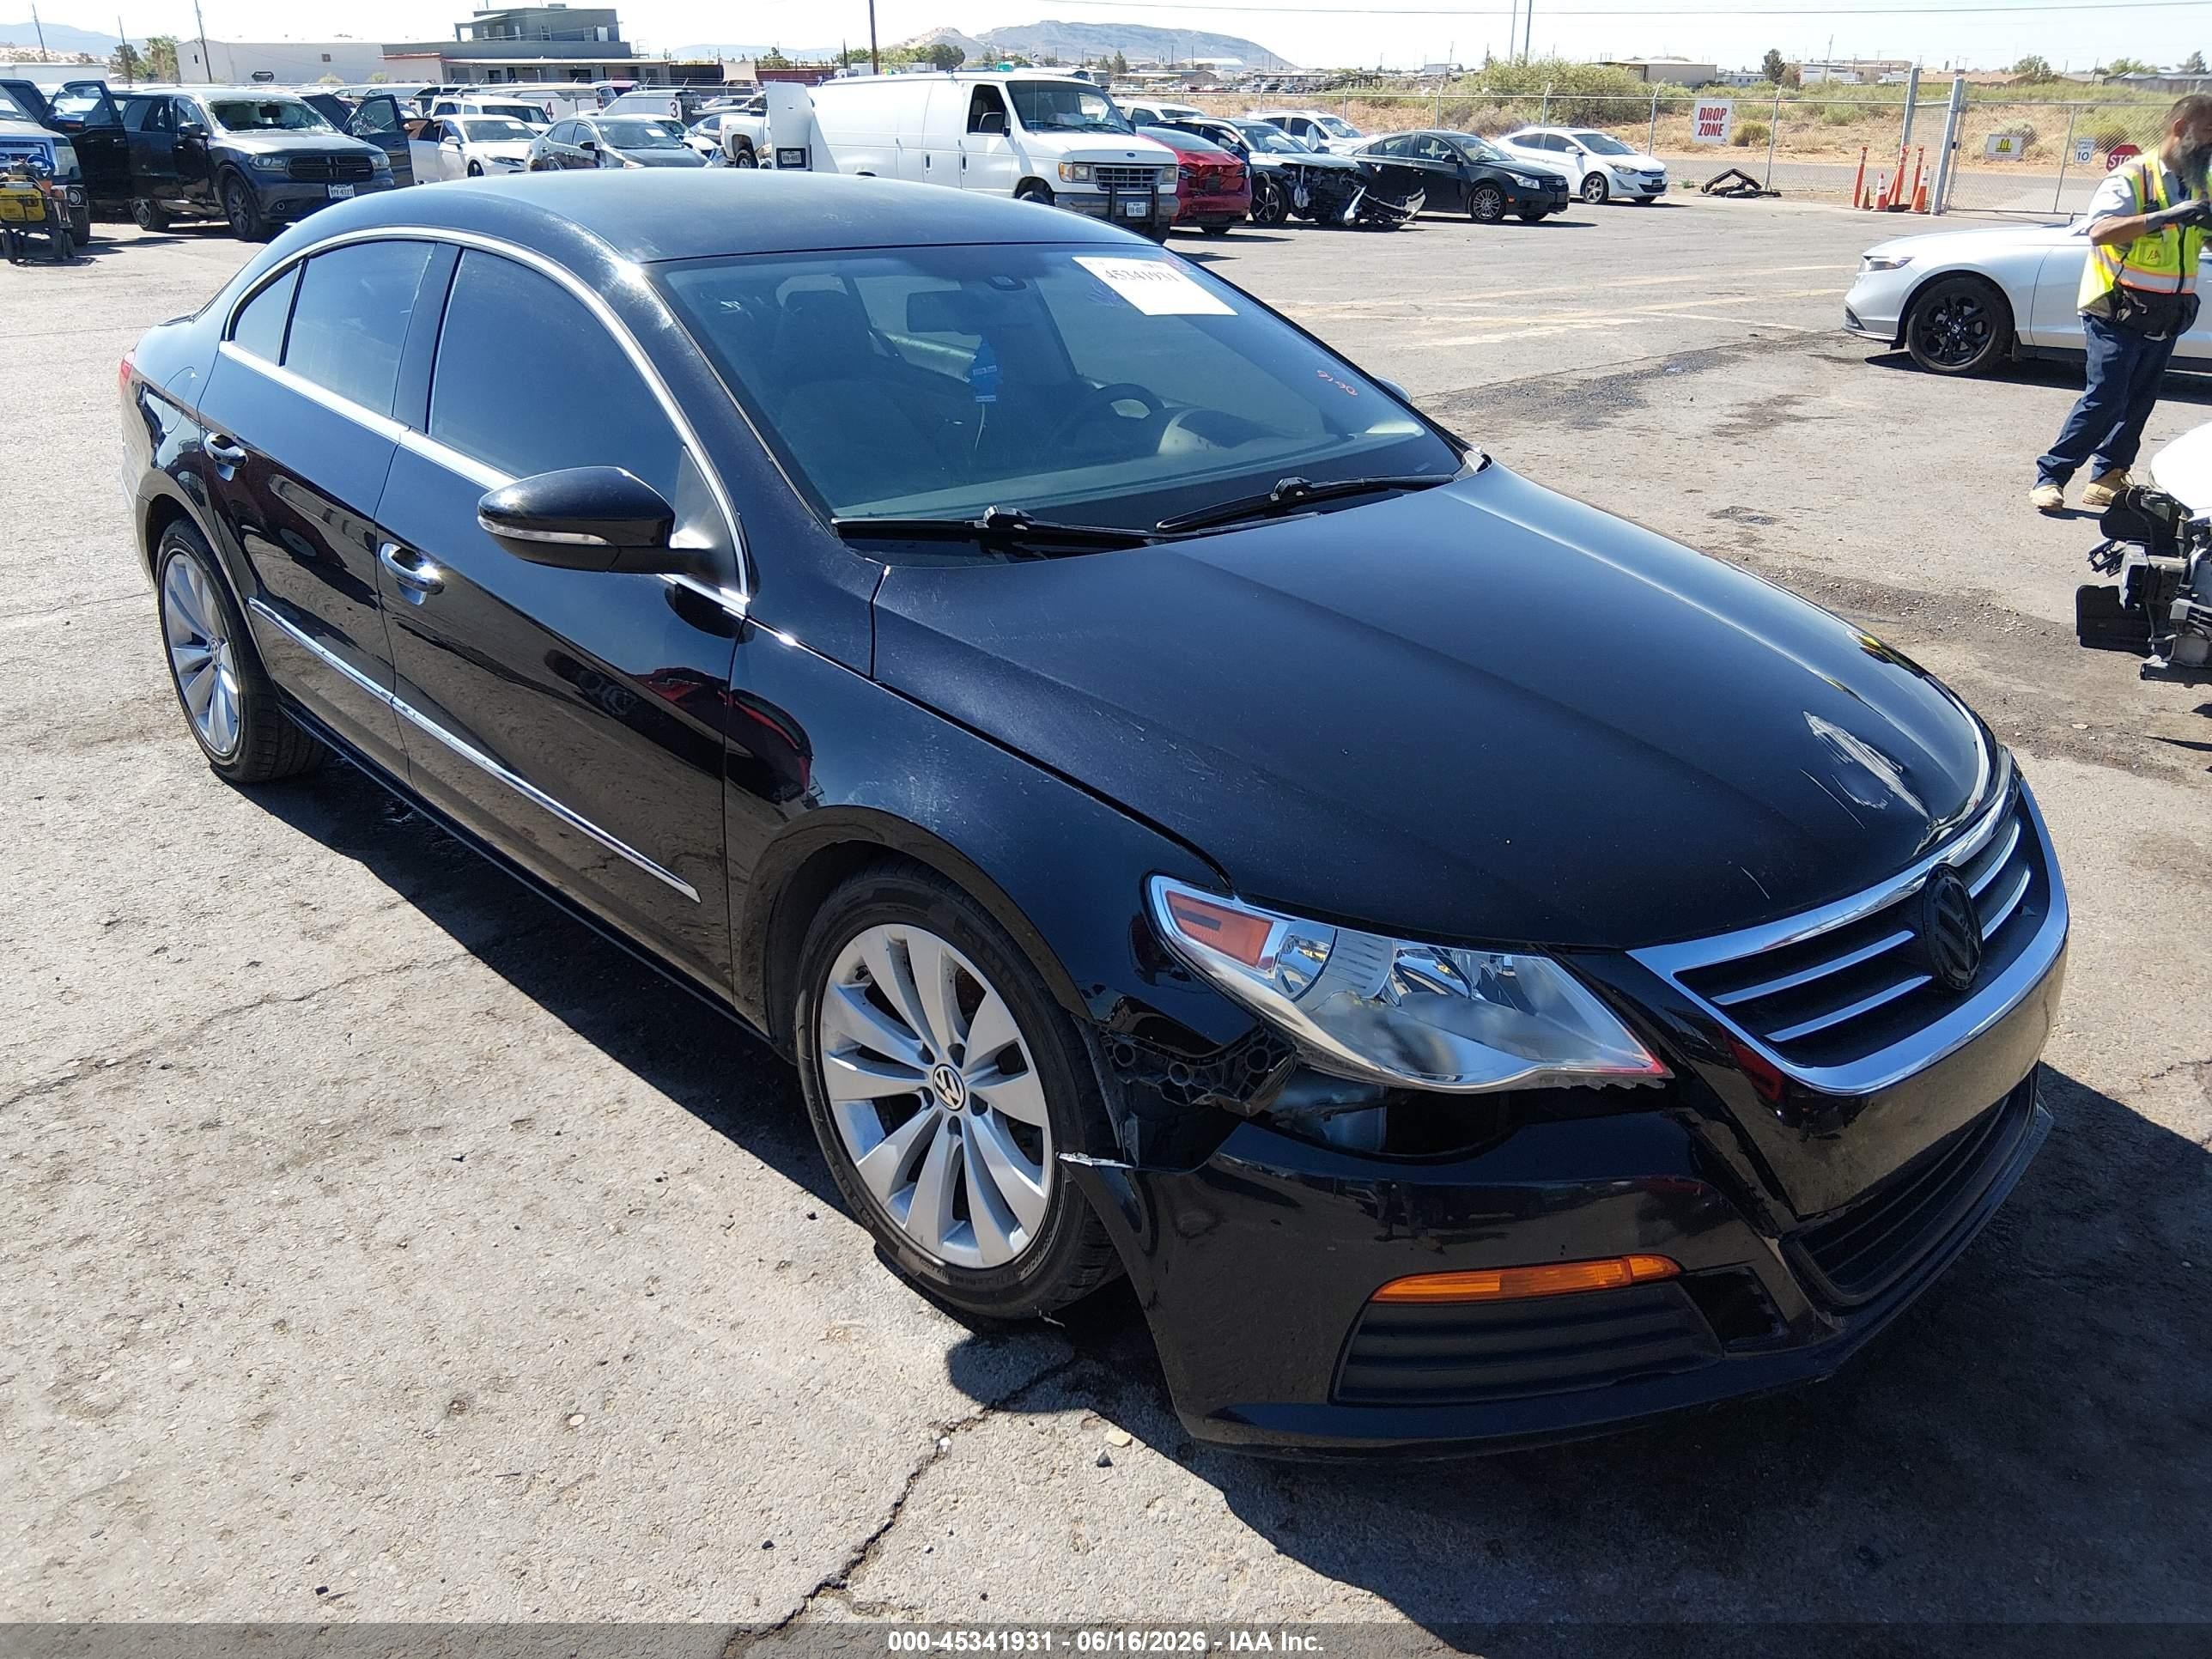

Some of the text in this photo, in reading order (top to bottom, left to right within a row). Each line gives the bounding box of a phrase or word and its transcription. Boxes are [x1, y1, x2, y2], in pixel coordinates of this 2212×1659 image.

[545, 101, 554, 118] 4
[670, 101, 678, 118] 3
[1698, 107, 1727, 121] DROP
[1698, 123, 1725, 137] ZONE
[2077, 152, 2089, 161] 10
[2108, 155, 2133, 167] STO
